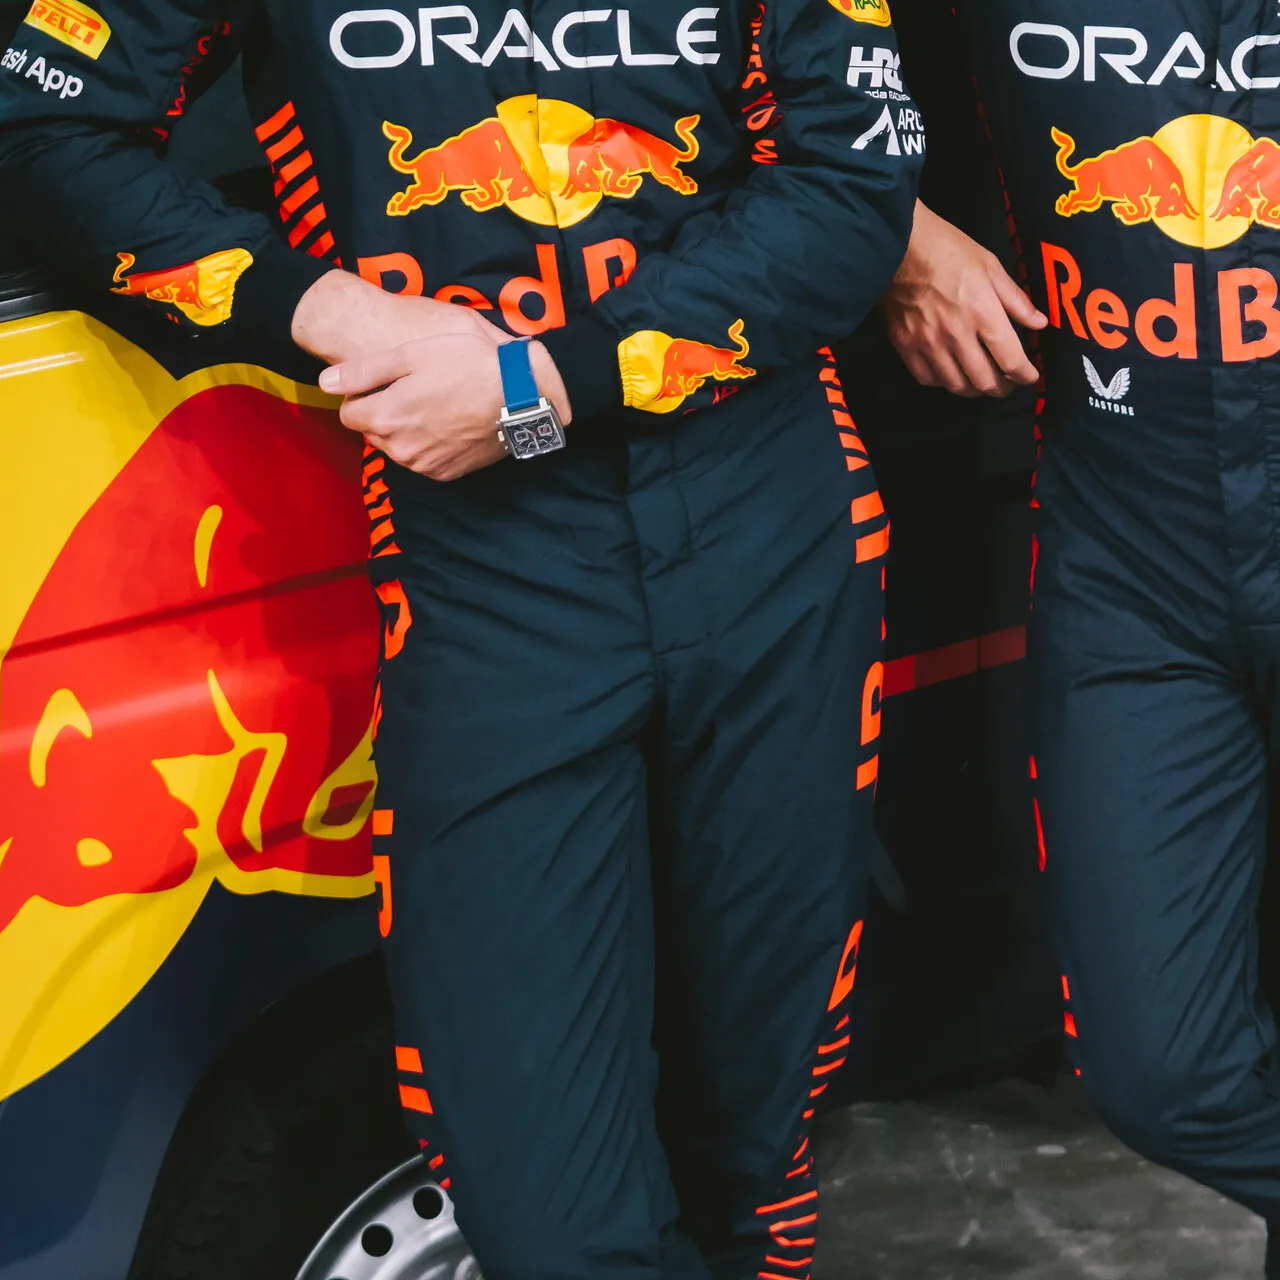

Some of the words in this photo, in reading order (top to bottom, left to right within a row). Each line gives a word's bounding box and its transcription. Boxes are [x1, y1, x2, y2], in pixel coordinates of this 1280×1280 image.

[329, 5, 721, 71] ORACLE
[25, 56, 84, 99] App
[1040, 240, 1200, 361] Red
[1088, 395, 1135, 416] CASTORE
